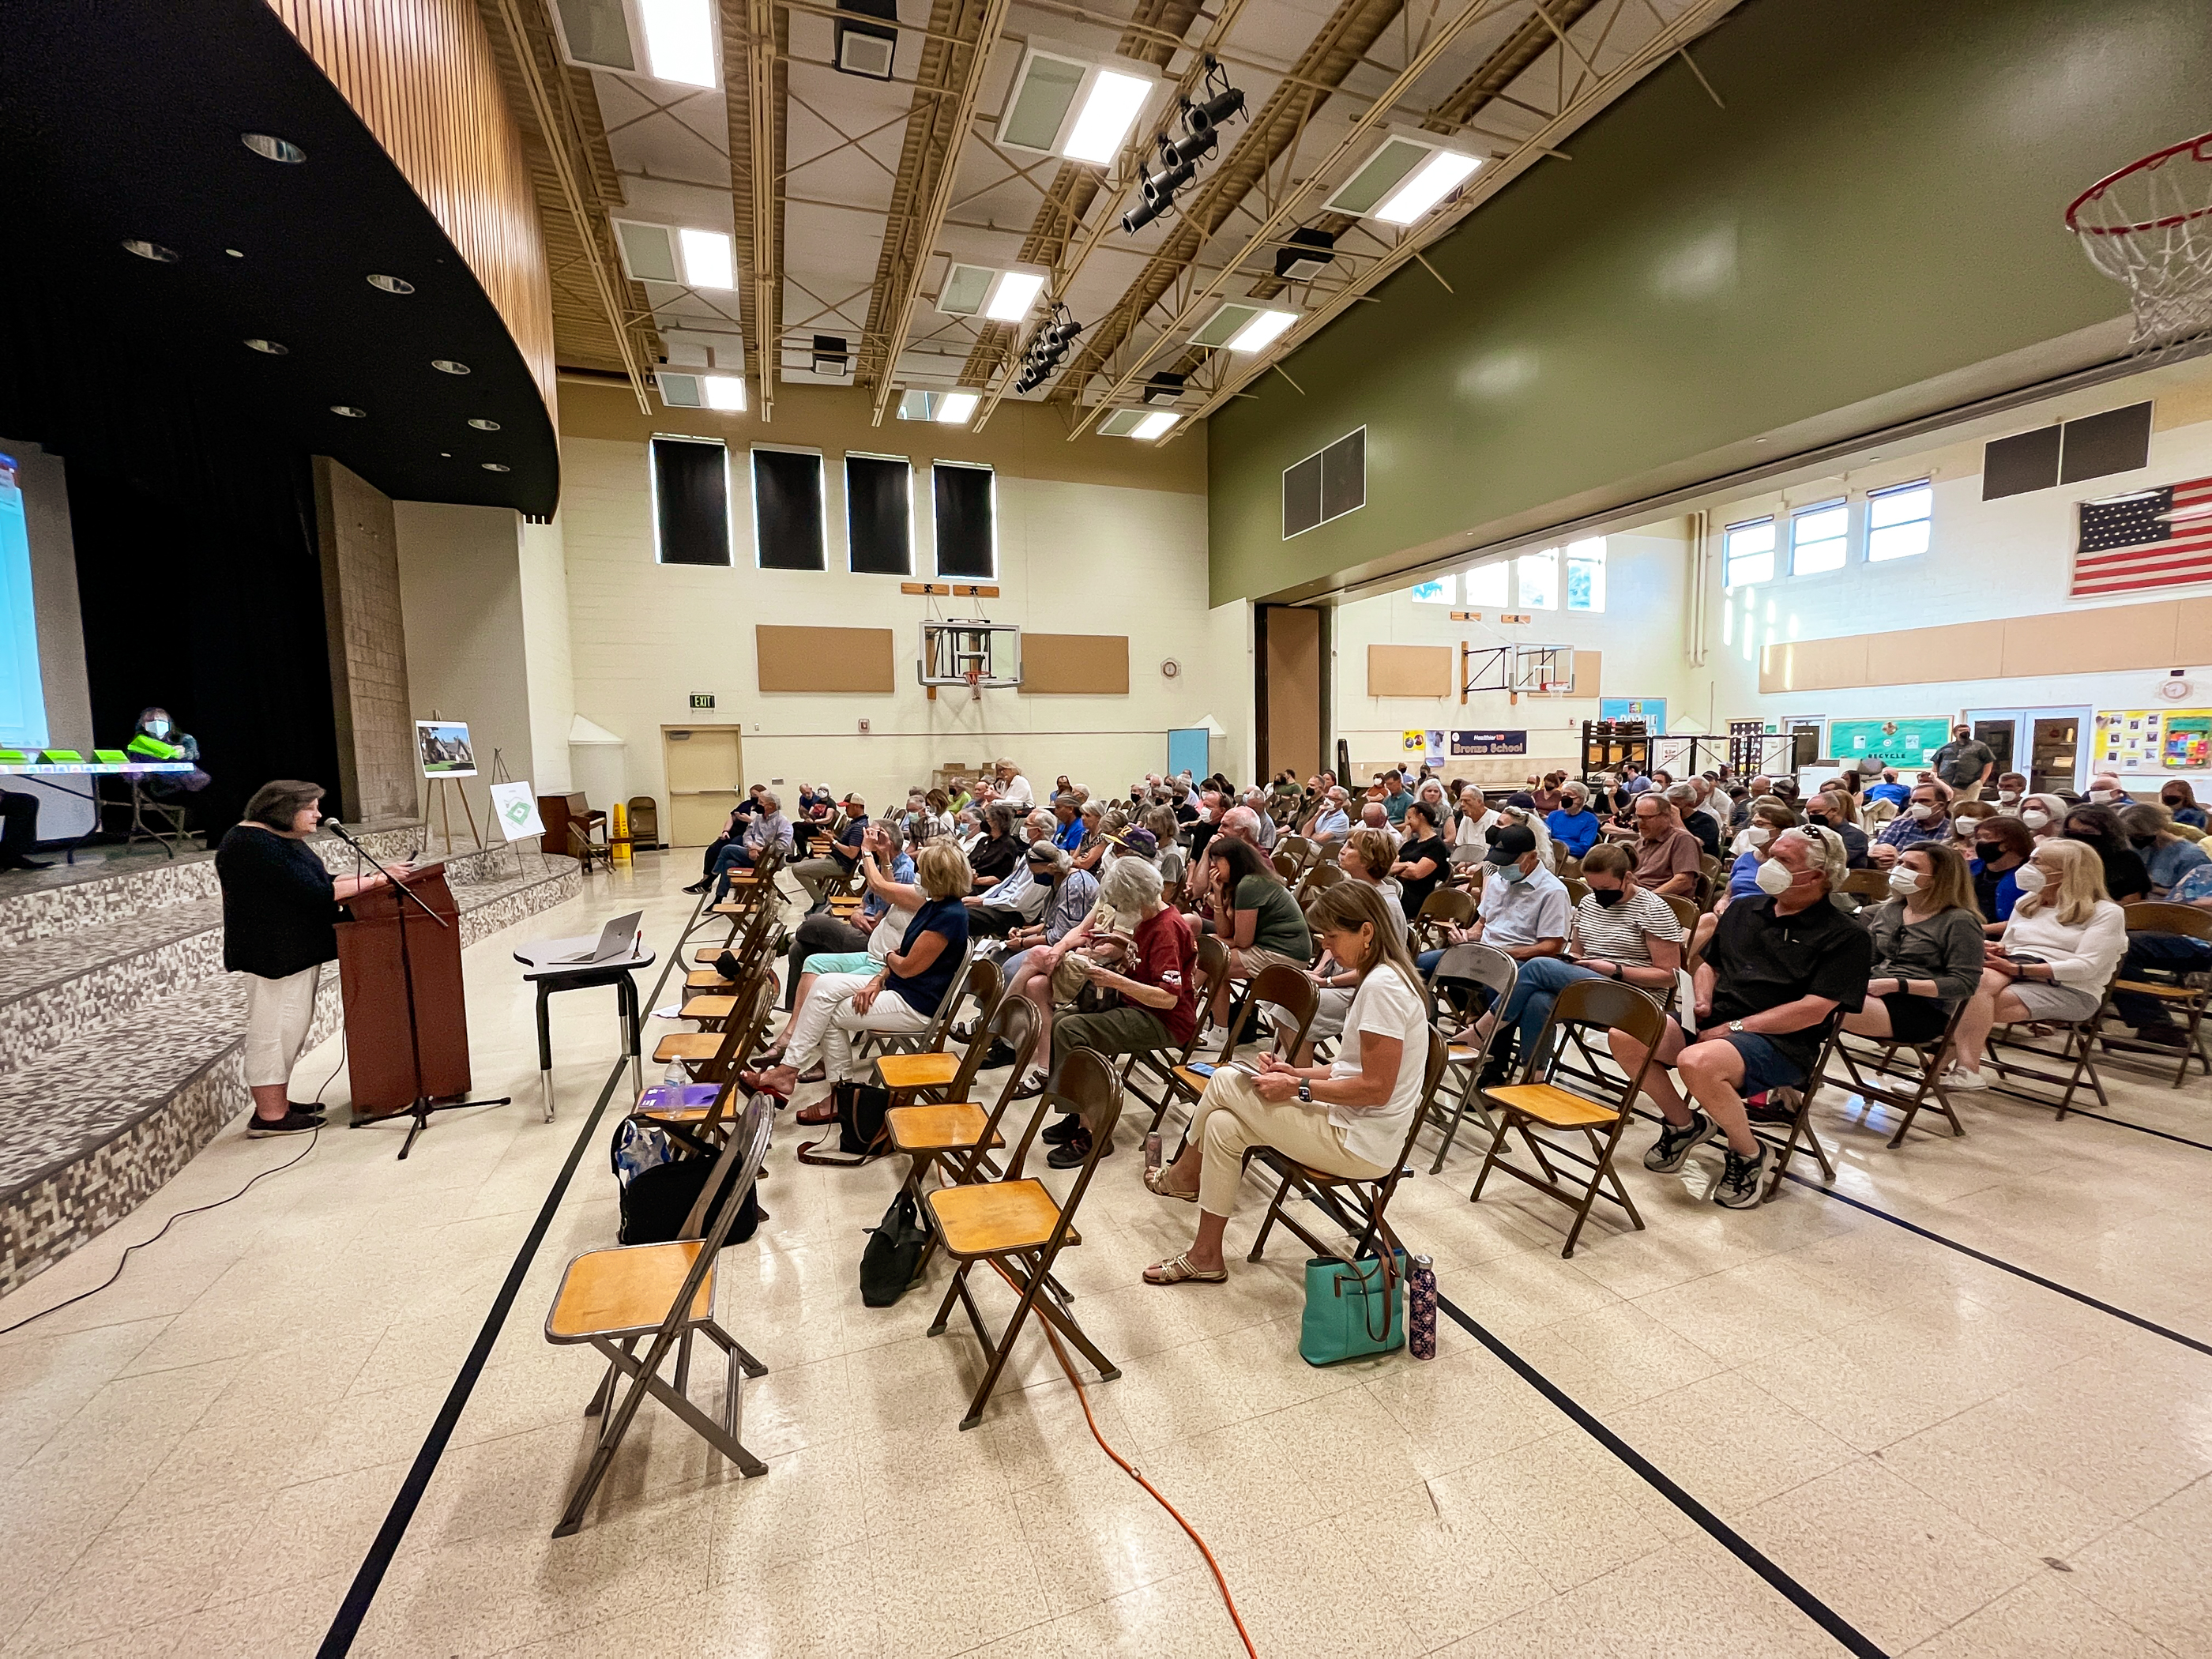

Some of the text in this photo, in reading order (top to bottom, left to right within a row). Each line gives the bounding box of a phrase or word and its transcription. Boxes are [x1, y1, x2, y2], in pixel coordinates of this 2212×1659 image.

[695, 696, 711, 707] EXIT
[1454, 743, 1523, 754] Bronze School
